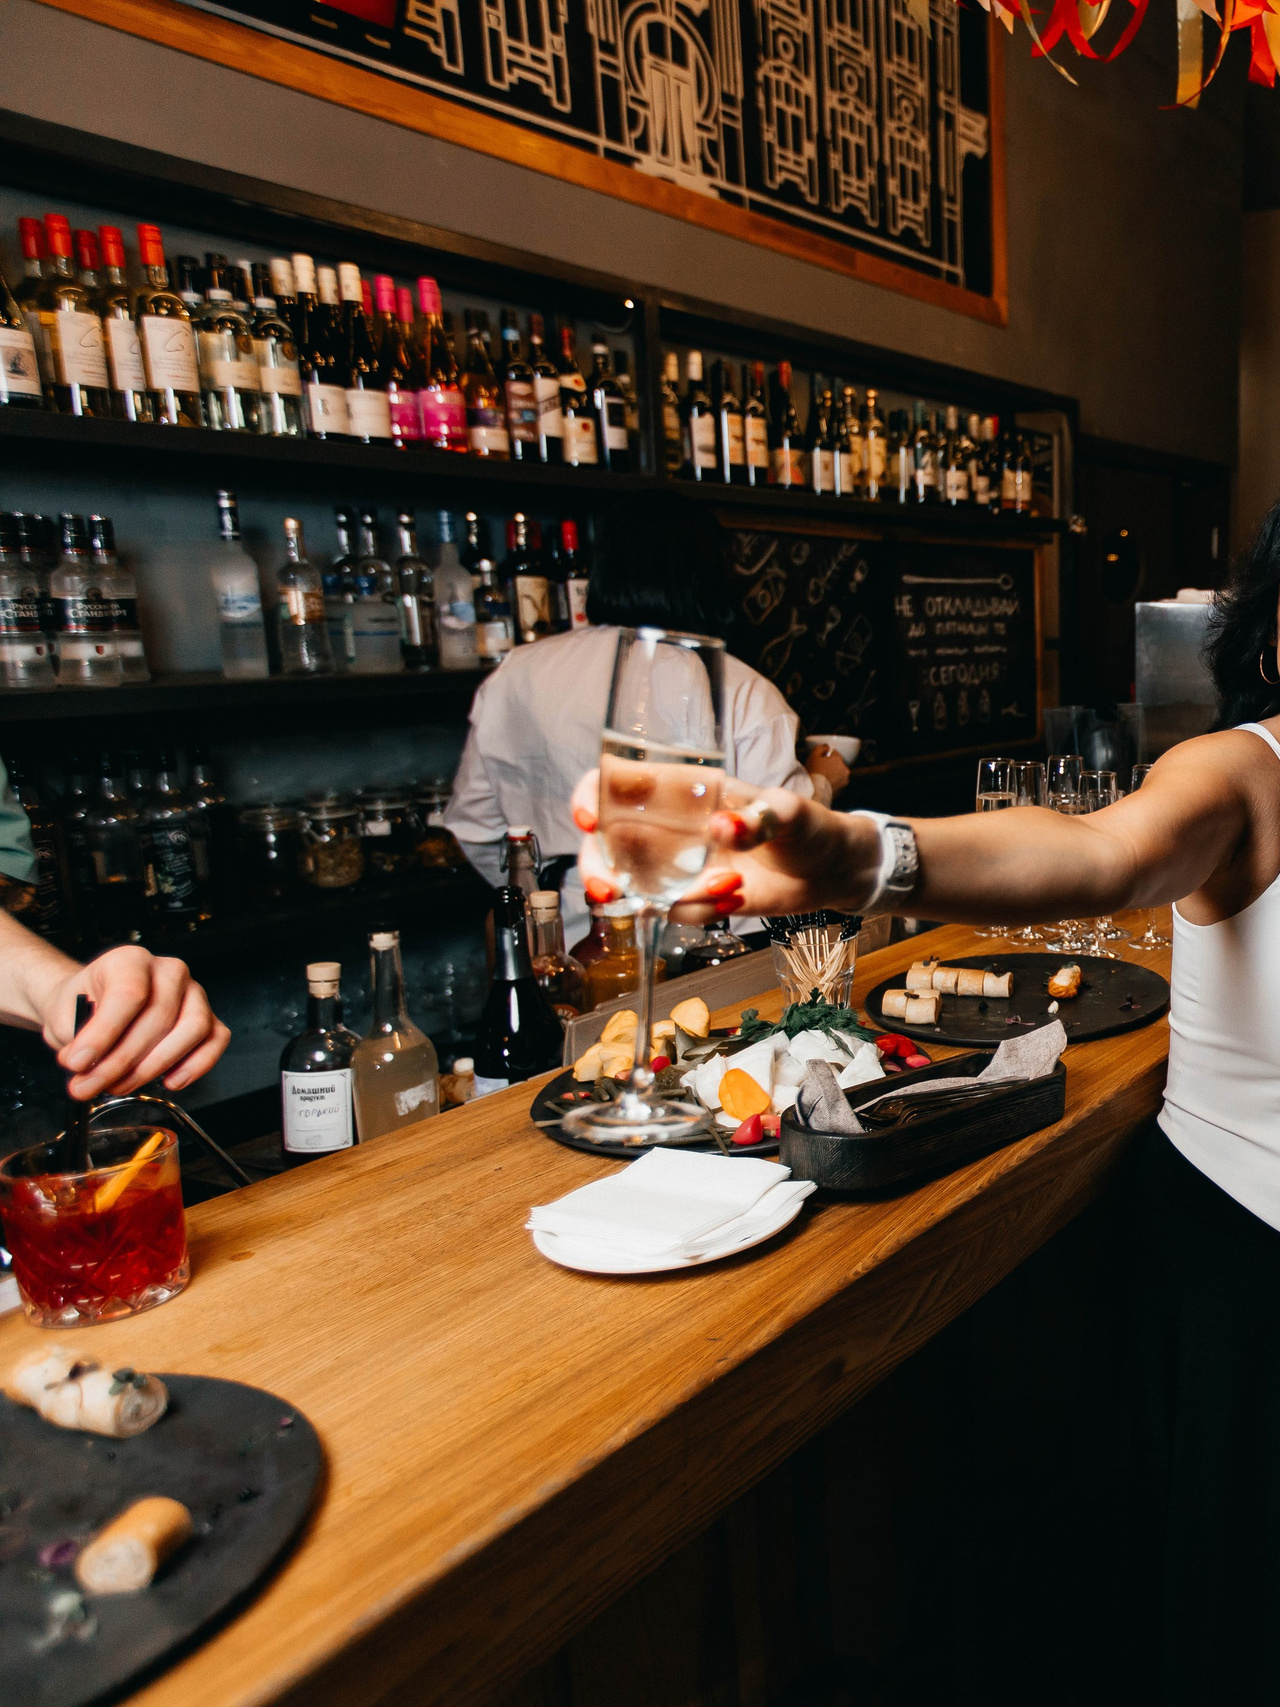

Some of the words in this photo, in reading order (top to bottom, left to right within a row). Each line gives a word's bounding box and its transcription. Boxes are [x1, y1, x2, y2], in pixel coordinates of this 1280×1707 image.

[894, 594, 914, 618] НЕ
[925, 592, 1020, 618] ОТКЛАДЫВАЙ
[929, 661, 1000, 687] СЕГОДНЯ
[291, 1084, 336, 1095] Домашний
